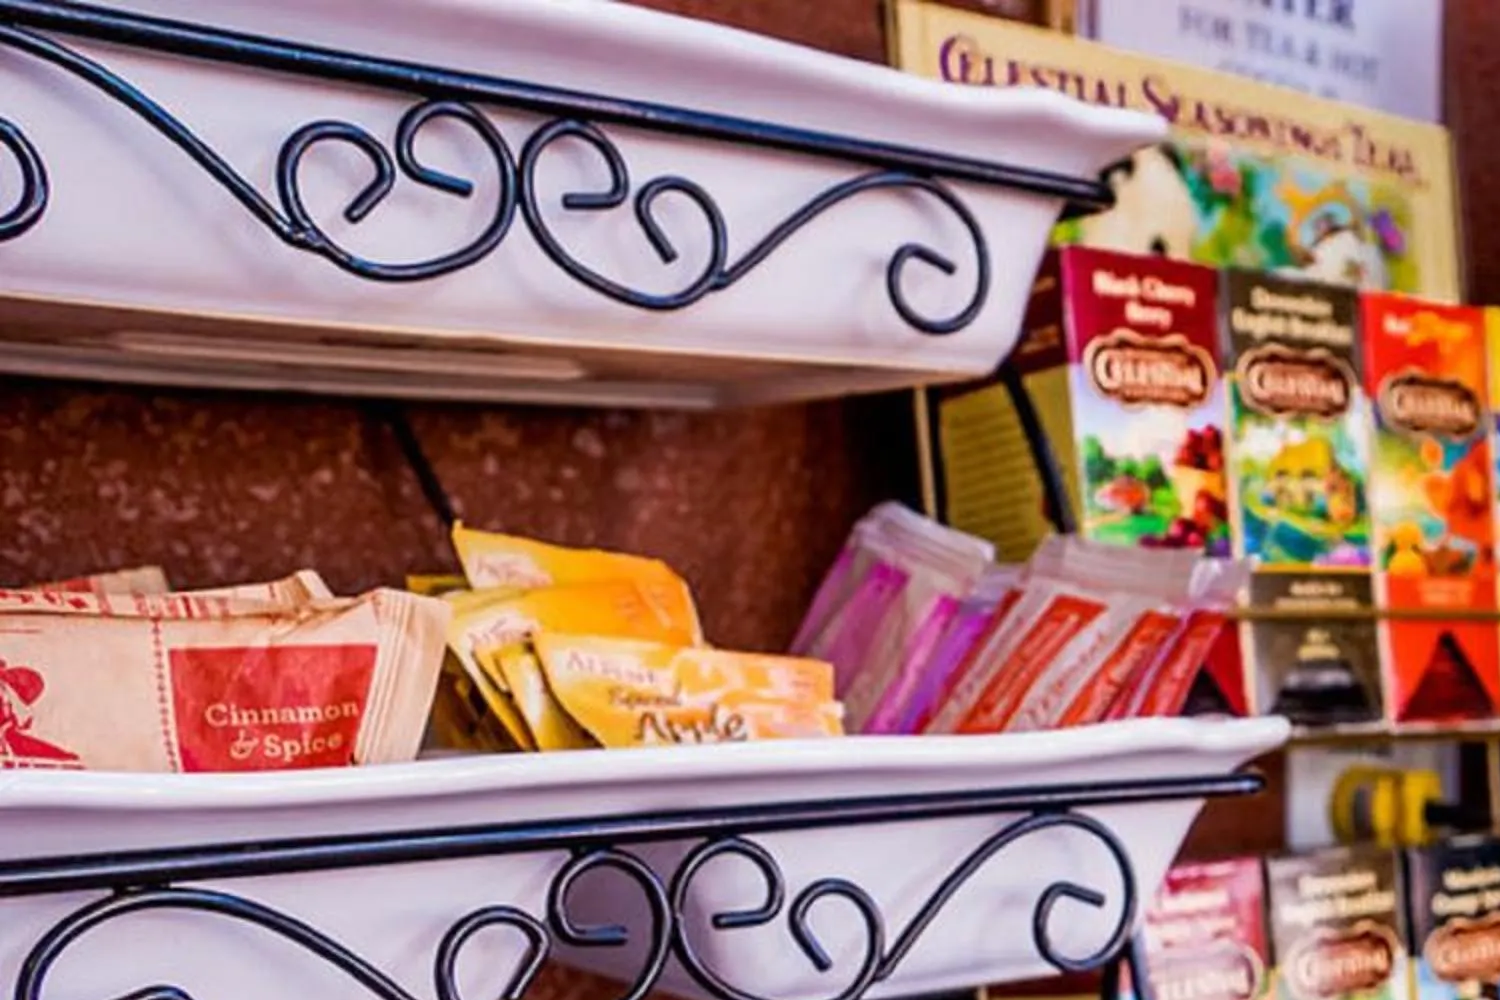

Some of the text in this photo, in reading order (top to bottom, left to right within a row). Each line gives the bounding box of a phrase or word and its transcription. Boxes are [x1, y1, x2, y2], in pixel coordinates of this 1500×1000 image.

[204, 701, 359, 727] Cinnamon
[229, 732, 343, 762] & Spice
